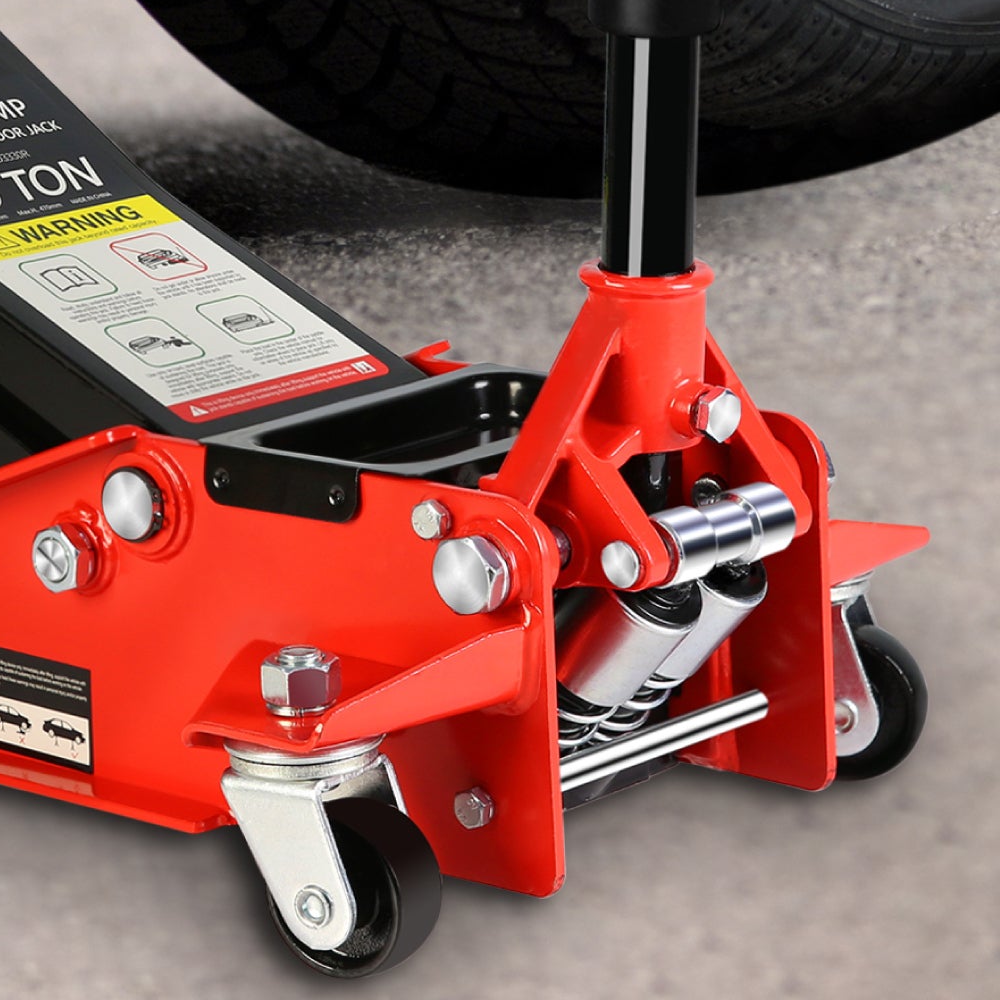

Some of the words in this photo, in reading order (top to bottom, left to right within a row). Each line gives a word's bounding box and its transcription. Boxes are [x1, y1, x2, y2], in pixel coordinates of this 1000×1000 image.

[25, 119, 63, 136] JACK
[0, 155, 104, 202] TON
[9, 205, 143, 244] WARNING
